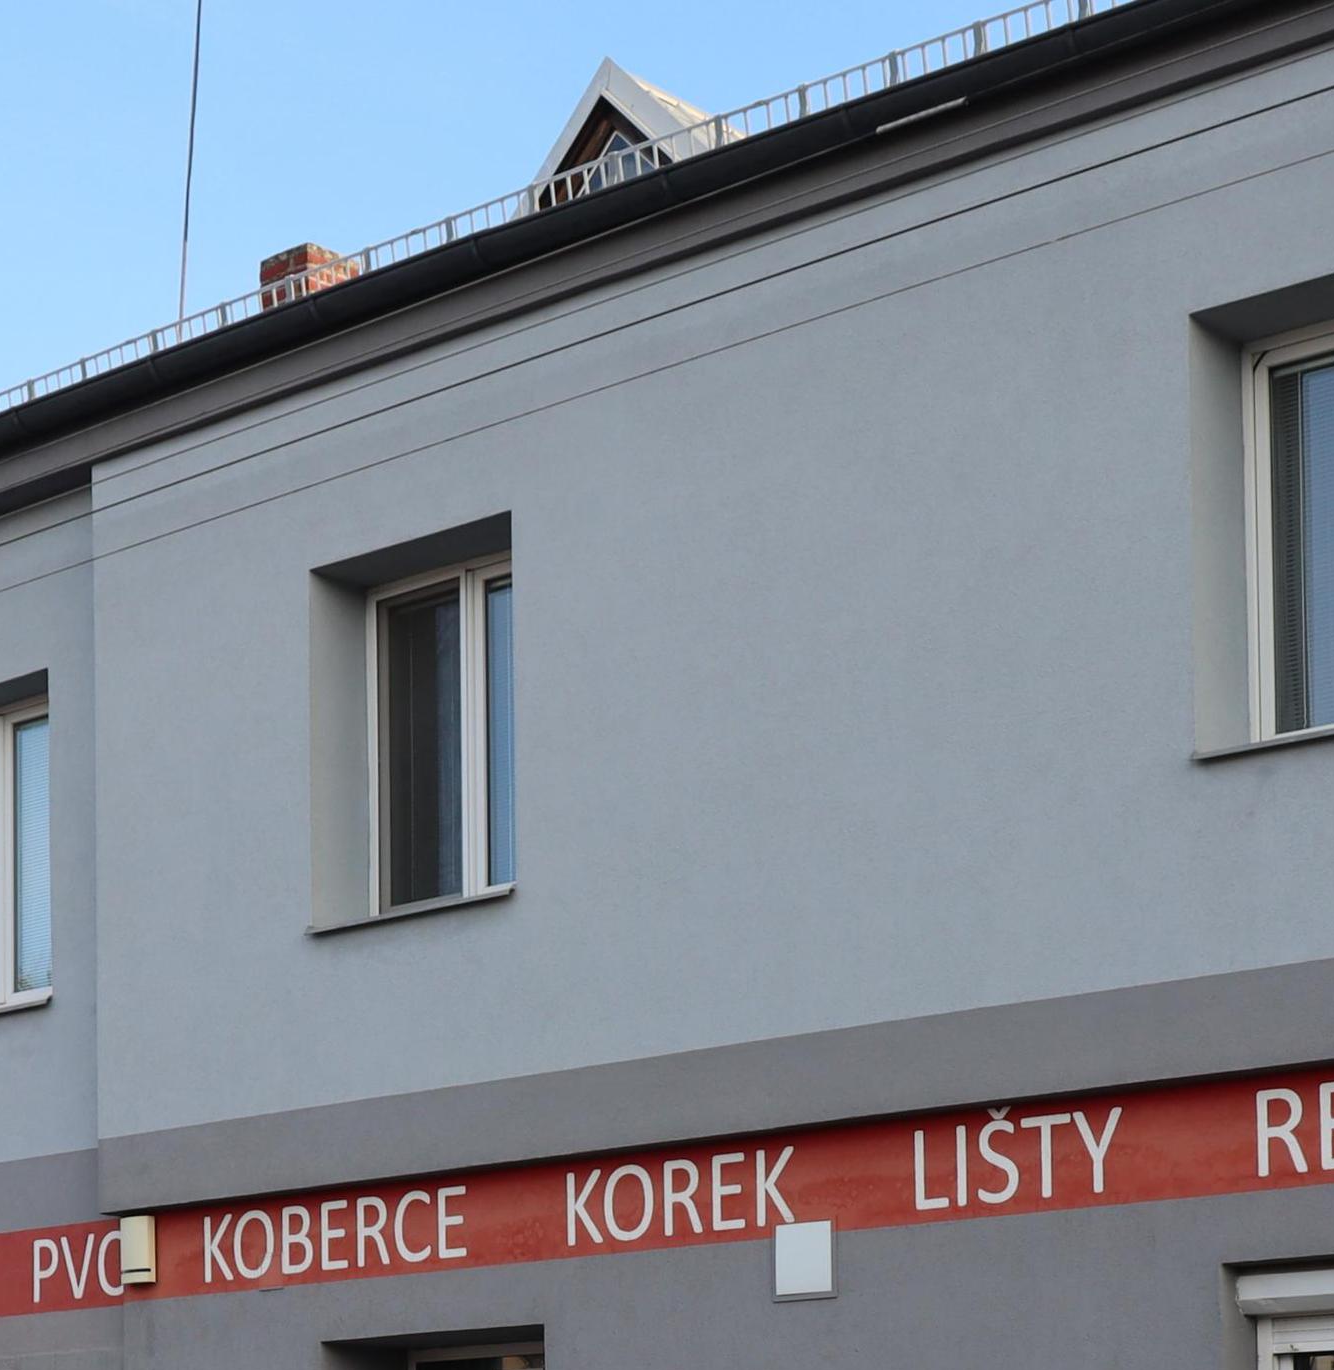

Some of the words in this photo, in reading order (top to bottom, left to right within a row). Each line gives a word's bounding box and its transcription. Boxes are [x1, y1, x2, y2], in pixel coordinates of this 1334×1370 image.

[203, 1186, 467, 1283] KOBERCE
[566, 1145, 795, 1246] KOREK
[914, 1107, 1123, 1211] LIŠTY
